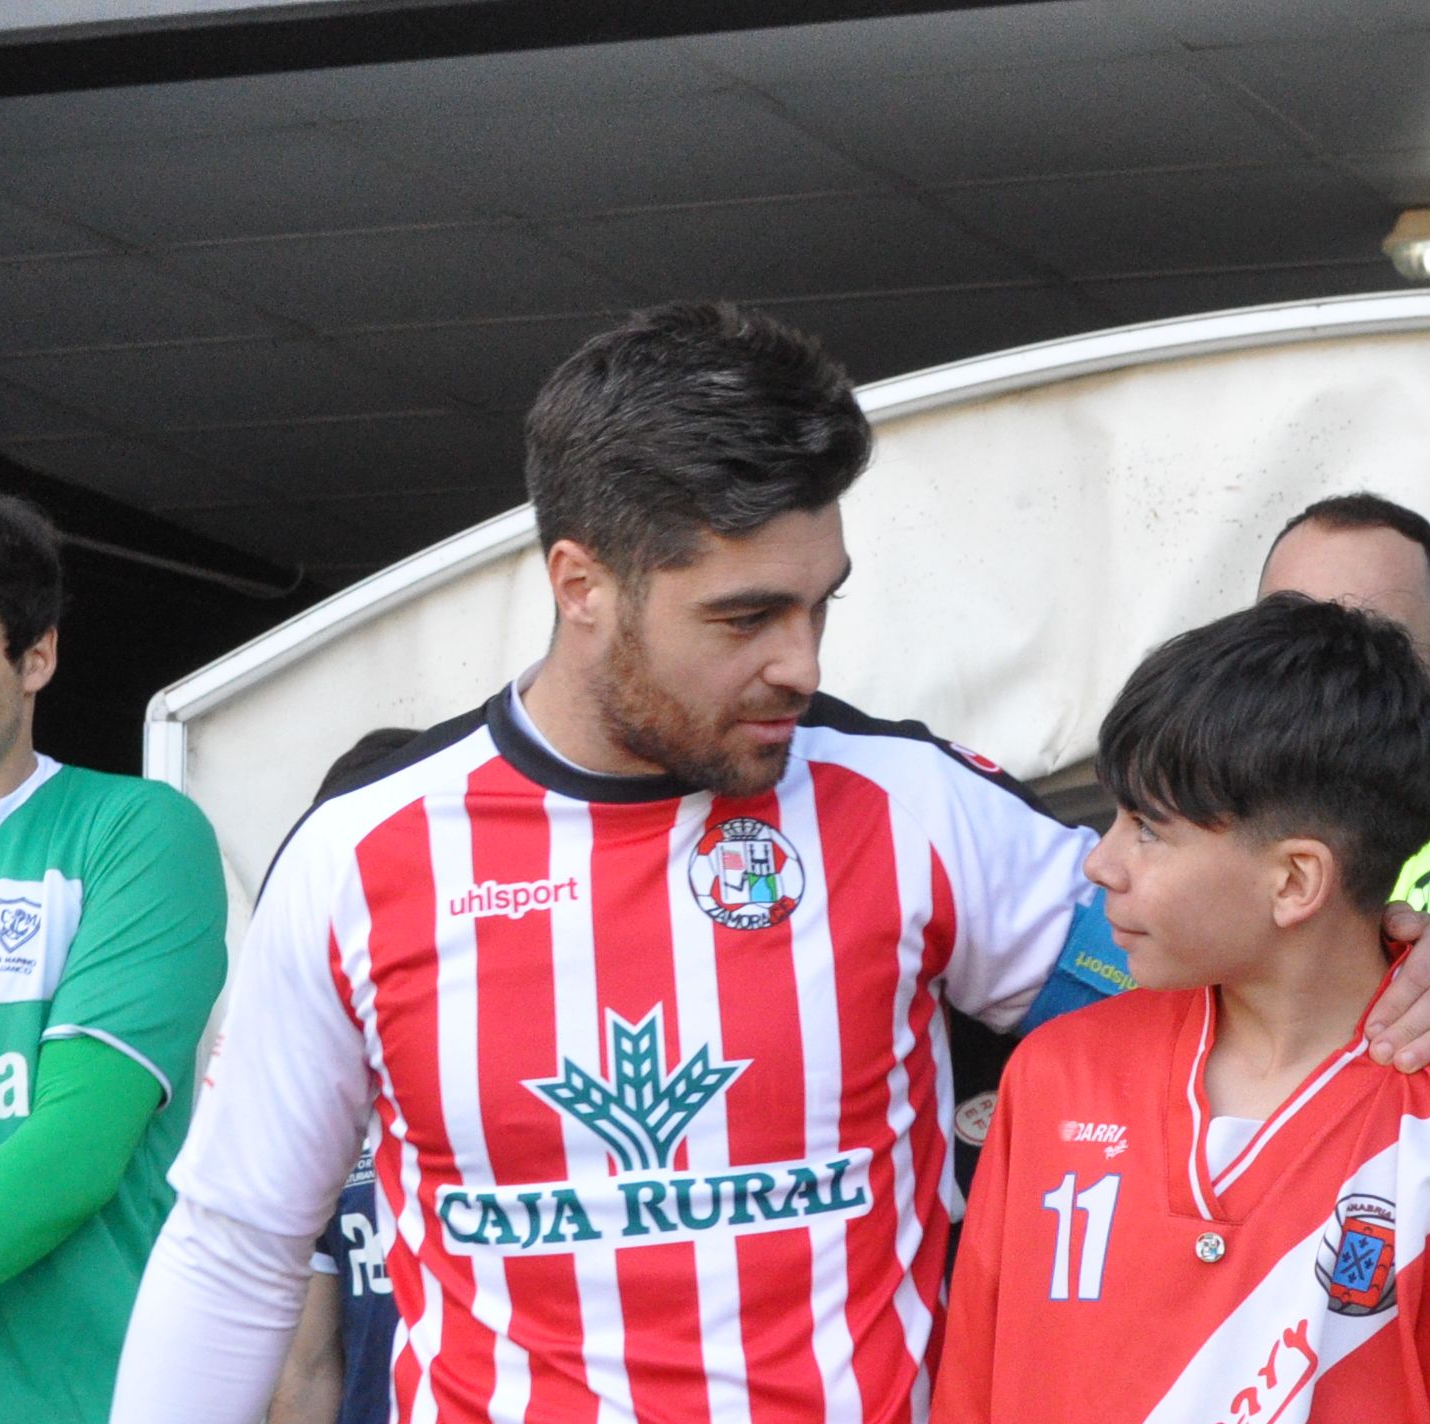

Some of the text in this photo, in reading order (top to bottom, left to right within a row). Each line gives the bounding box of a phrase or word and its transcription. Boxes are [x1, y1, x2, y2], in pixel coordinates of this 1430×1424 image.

[449, 876, 579, 917] uhlsport
[439, 1158, 868, 1249] CAJA RURAL
[1041, 1171, 1121, 1302] 11
